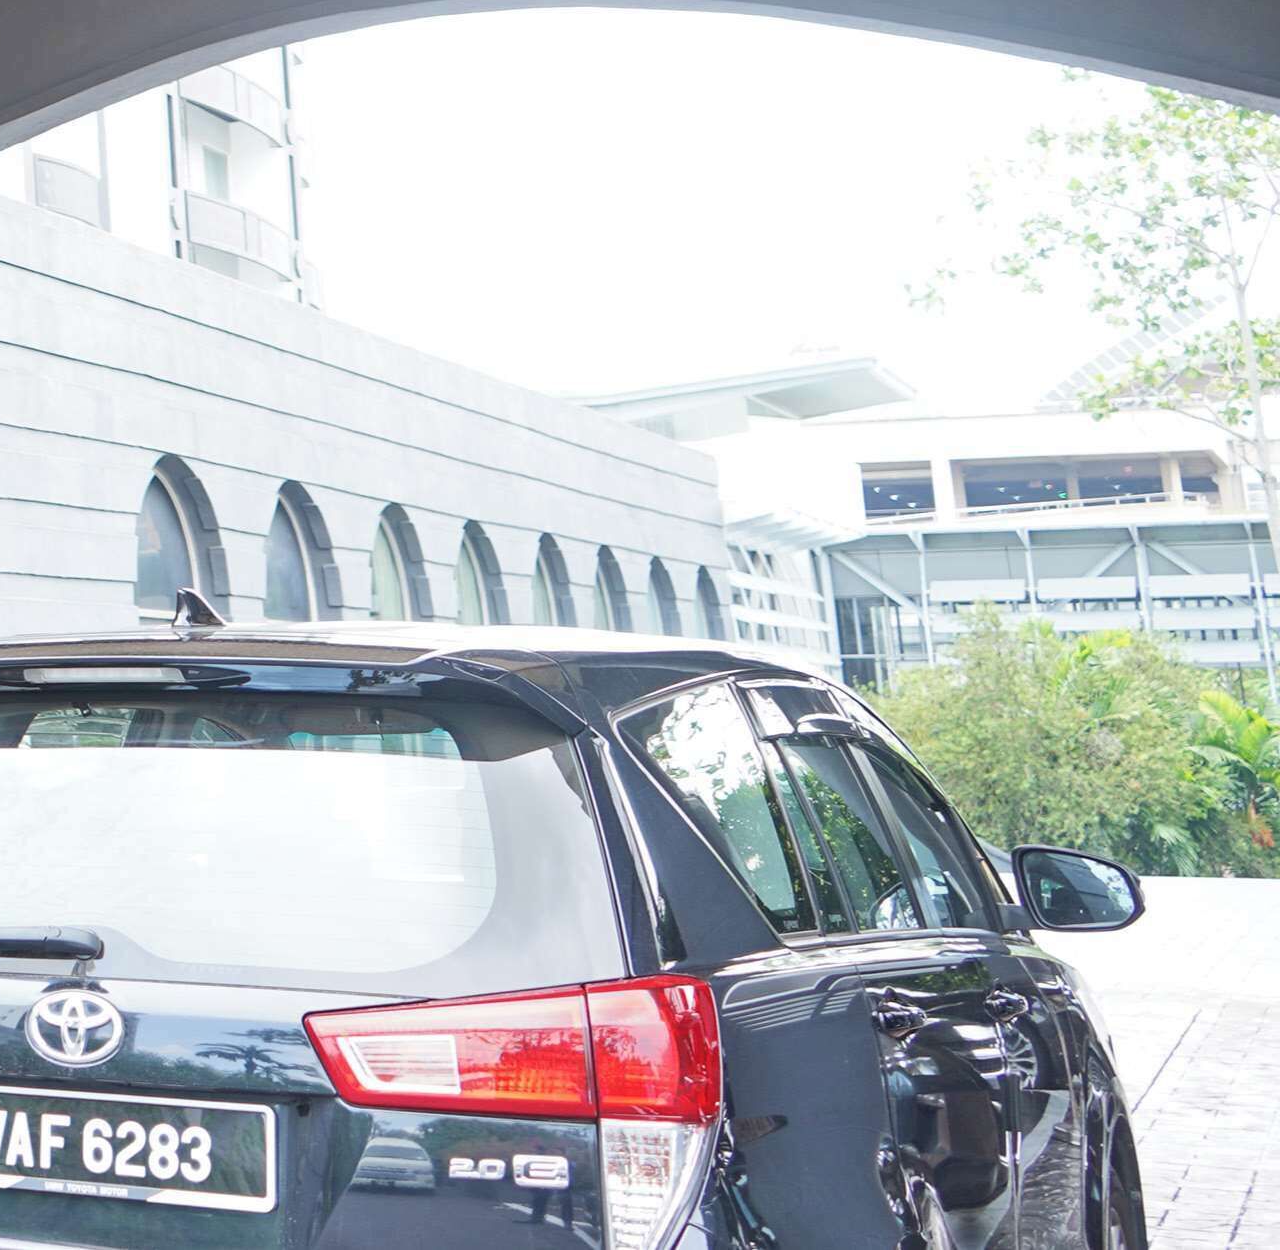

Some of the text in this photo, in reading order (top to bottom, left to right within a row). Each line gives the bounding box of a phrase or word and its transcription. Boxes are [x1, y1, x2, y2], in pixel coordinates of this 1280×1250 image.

[81, 1118, 212, 1183] 6283
[449, 1157, 506, 1181] 2.0
[66, 1182, 98, 1195] TOYOTA
